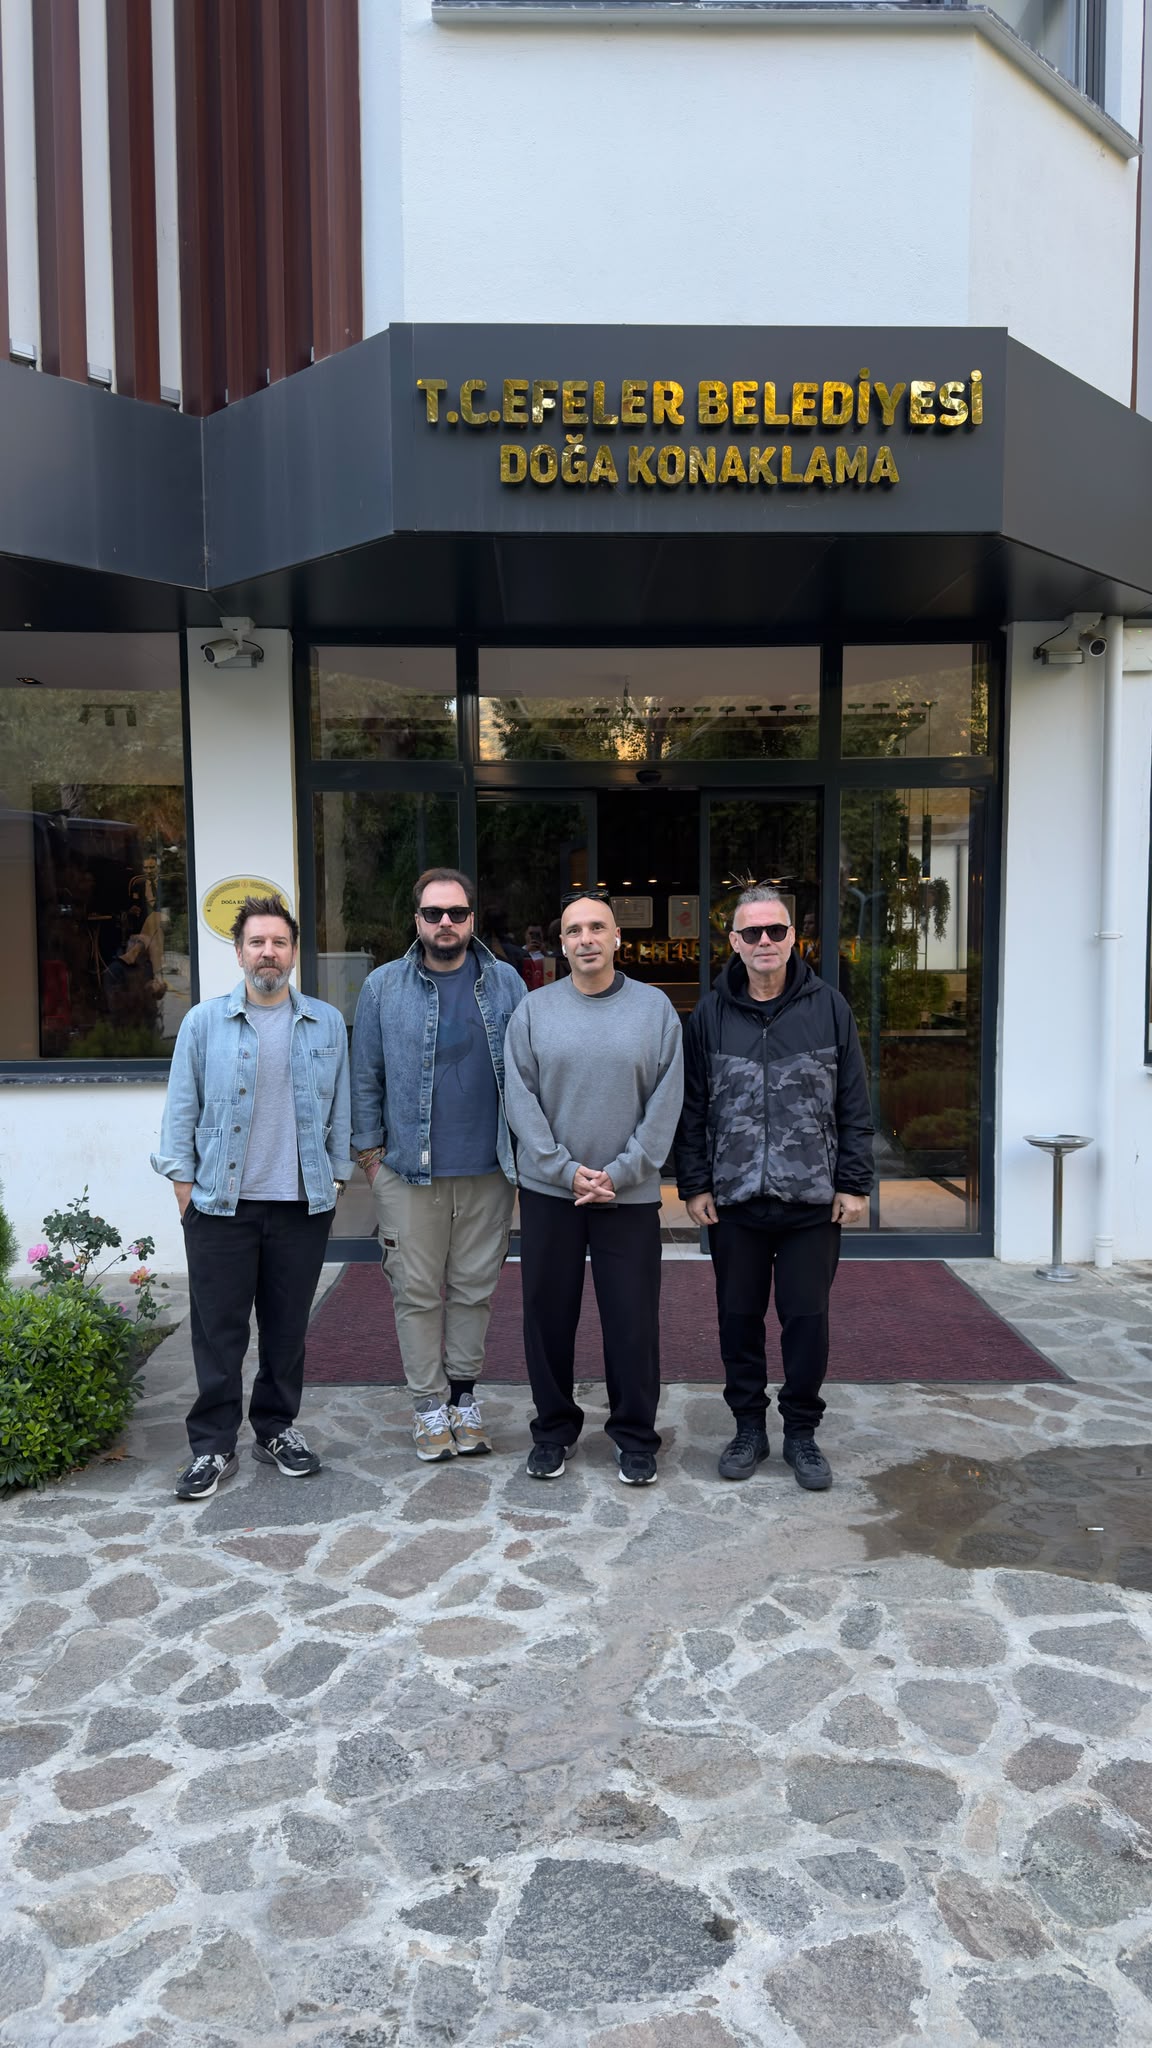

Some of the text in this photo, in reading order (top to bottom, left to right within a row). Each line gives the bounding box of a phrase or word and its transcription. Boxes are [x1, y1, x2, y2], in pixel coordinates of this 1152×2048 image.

[697, 367, 984, 427] BELEDİYESİ
[500, 433, 900, 485] DOĞA KONAKLAMA
